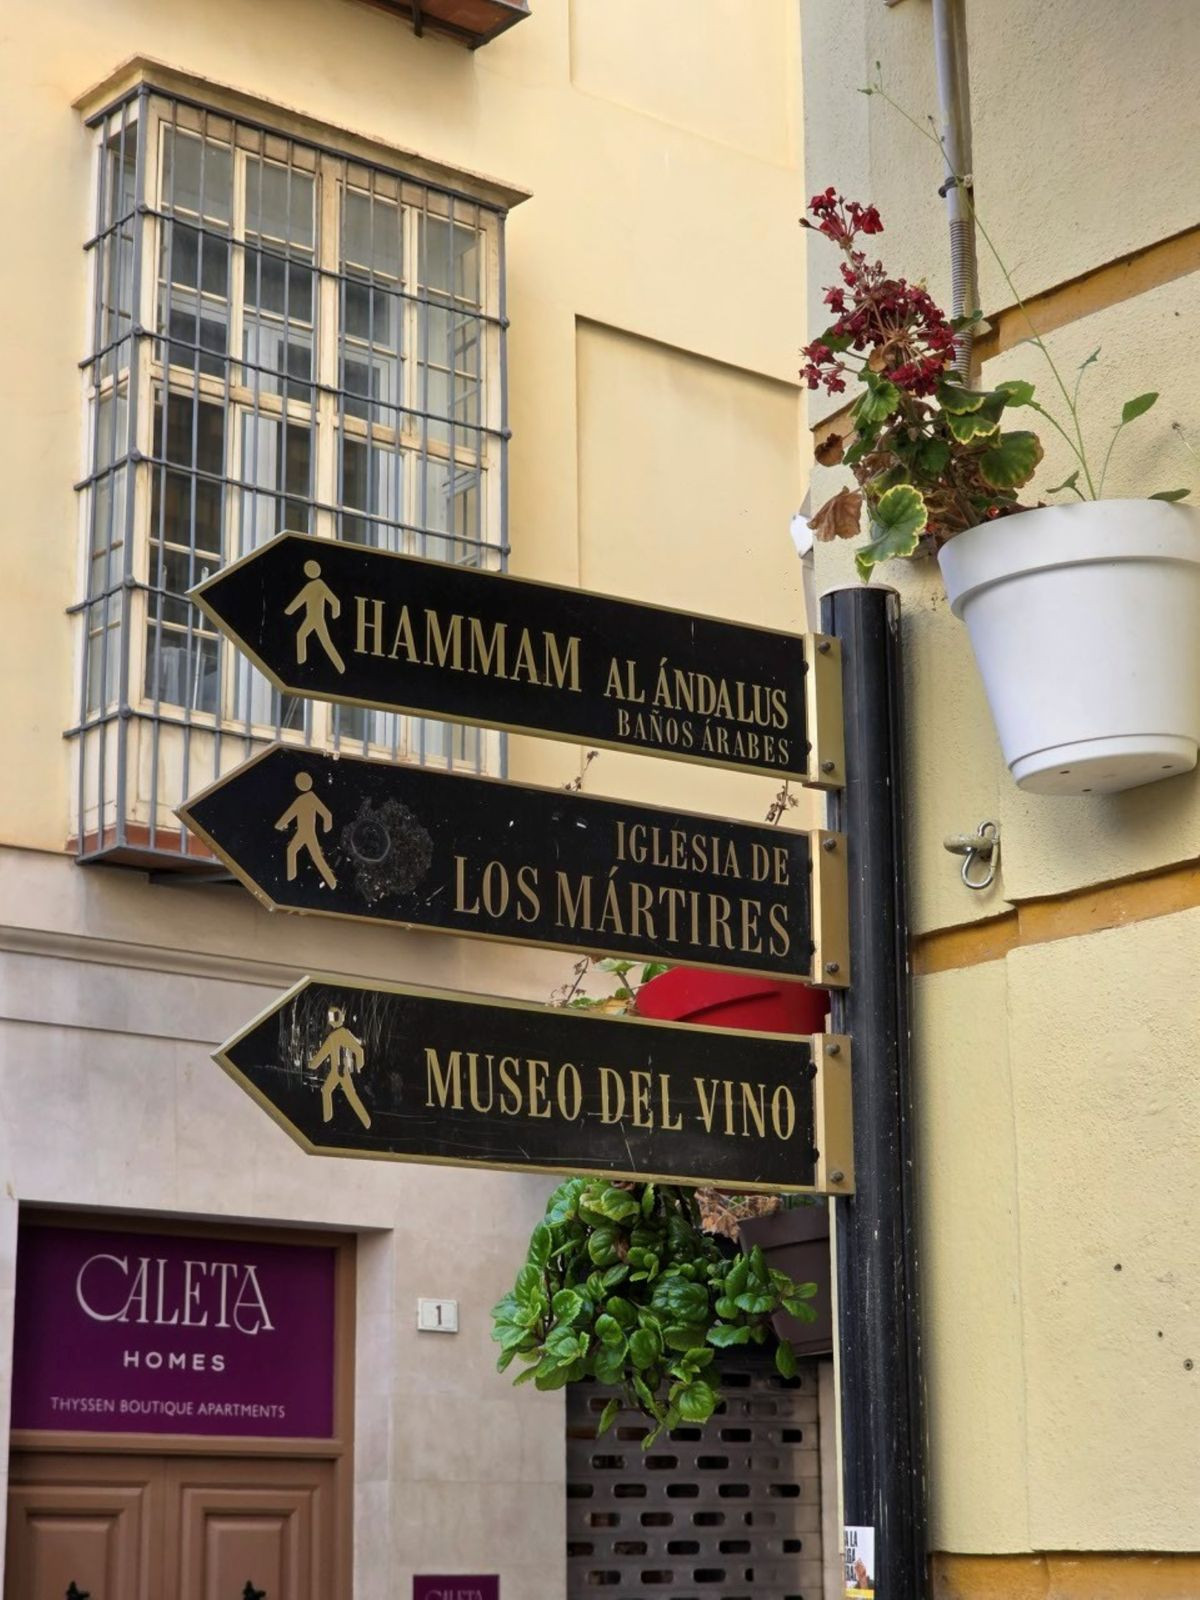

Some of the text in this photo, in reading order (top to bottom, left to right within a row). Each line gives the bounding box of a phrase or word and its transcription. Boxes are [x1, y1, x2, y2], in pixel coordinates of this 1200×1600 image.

[353, 595, 788, 729] HAMMAM AL ÁNDALUS
[618, 708, 790, 765] BAÑOS ÁRABES
[616, 821, 789, 886] IGLESIA DE
[453, 855, 790, 957] LOS MÁRTIRES
[425, 1047, 796, 1140] MUSEO DEL VINO
[76, 1254, 275, 1335] CALETA
[435, 1304, 442, 1326] 1
[123, 1350, 225, 1372] HOMES
[51, 1396, 285, 1419] THYSSEN BOUTIQUE APARTMENTS
